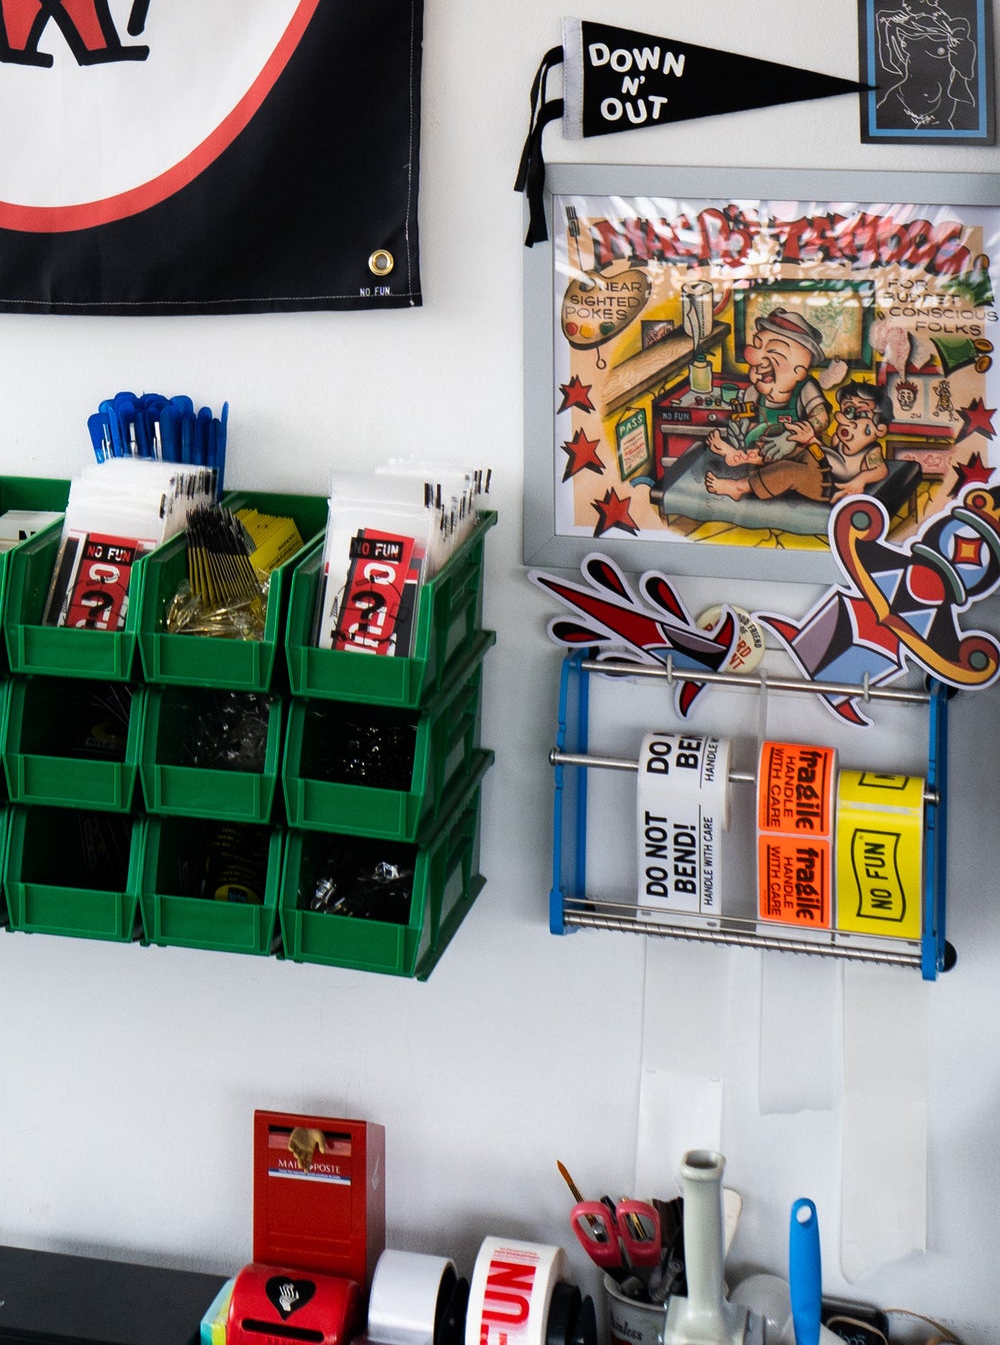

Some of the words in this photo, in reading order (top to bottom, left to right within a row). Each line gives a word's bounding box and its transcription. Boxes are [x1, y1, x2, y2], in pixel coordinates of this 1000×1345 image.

[588, 42, 686, 78] DOWN
[621, 75, 646, 96] N'
[600, 95, 668, 124] OUT
[360, 287, 371, 297] NO
[374, 286, 391, 296] FUN
[598, 281, 643, 294] NEAR
[888, 278, 929, 291] FOR
[565, 306, 628, 321] POKES
[569, 294, 641, 309] SIGHTED
[889, 306, 999, 322] CONSCIOUS
[914, 320, 982, 337] FOLKS
[619, 413, 643, 436] PASS
[662, 412, 673, 420] NO
[674, 413, 690, 421] FUN
[87, 544, 103, 558] NO
[107, 547, 131, 563] FUN
[375, 542, 399, 558] FUN
[646, 740, 673, 775] DO
[704, 743, 718, 782] HANDLE
[772, 748, 785, 780] WITH
[783, 756, 796, 818] HANDLE
[795, 750, 823, 830] fragile
[770, 783, 782, 828] CARE
[644, 810, 668, 860] NOT
[703, 816, 713, 842] CARE
[673, 823, 697, 895] BEND!
[703, 843, 713, 867] WITH
[770, 846, 782, 880] WITH
[864, 841, 889, 880] FUN
[645, 866, 669, 898] DO
[703, 868, 713, 906] HANDLE
[783, 856, 794, 909] HANDLE
[795, 846, 820, 920] fragile
[770, 883, 782, 917] CARE
[870, 888, 893, 910] NO
[278, 1158, 298, 1169] MAI
